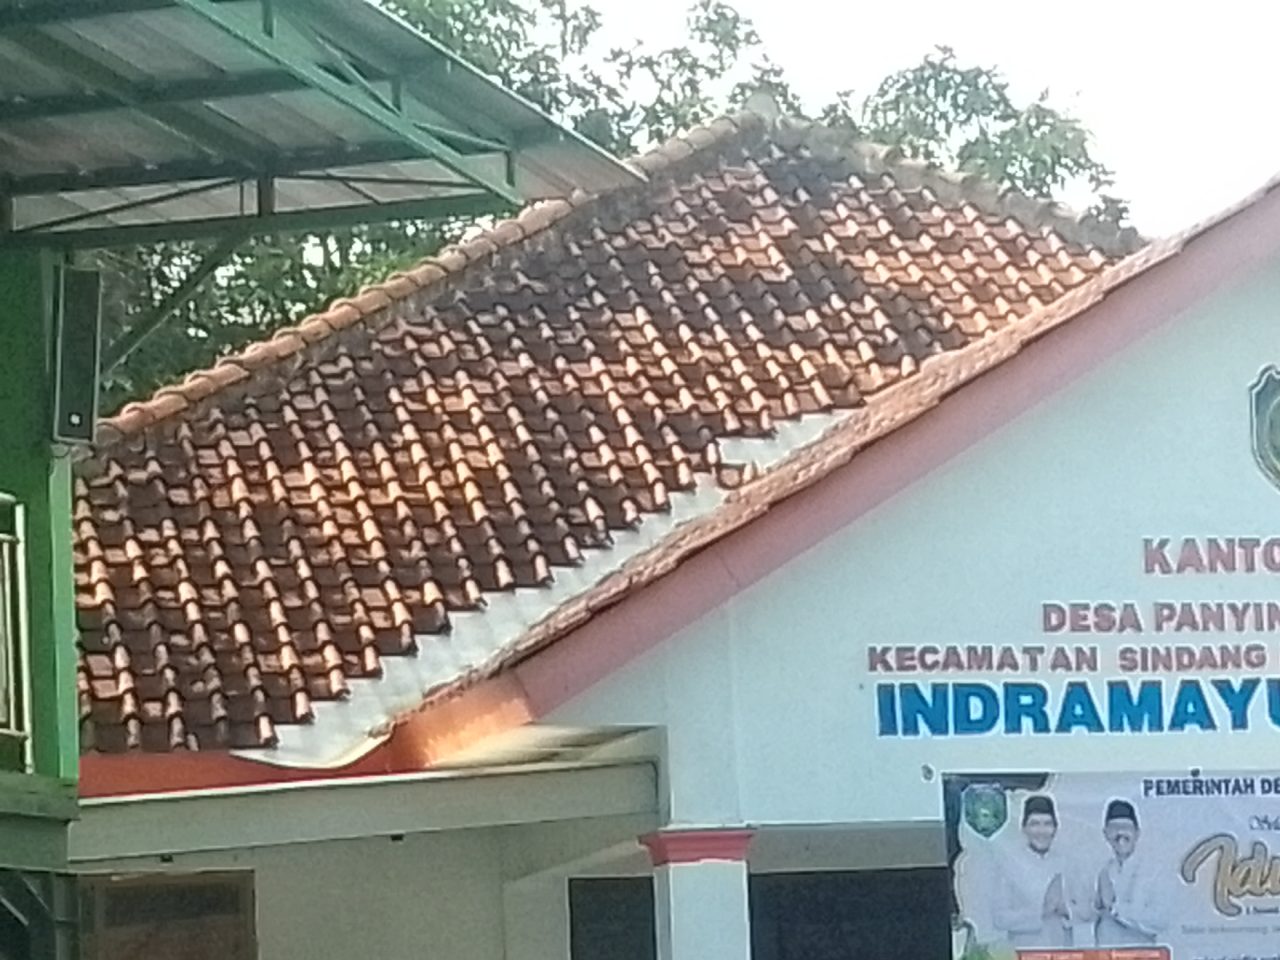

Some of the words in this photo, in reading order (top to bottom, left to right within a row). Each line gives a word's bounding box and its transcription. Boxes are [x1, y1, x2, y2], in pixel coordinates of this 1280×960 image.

[1042, 602, 1143, 633] DESA
[867, 645, 1098, 672] KECAMATAN
[1118, 643, 1267, 672] SINDANG
[1143, 778, 1255, 797] PEMERINTAH
